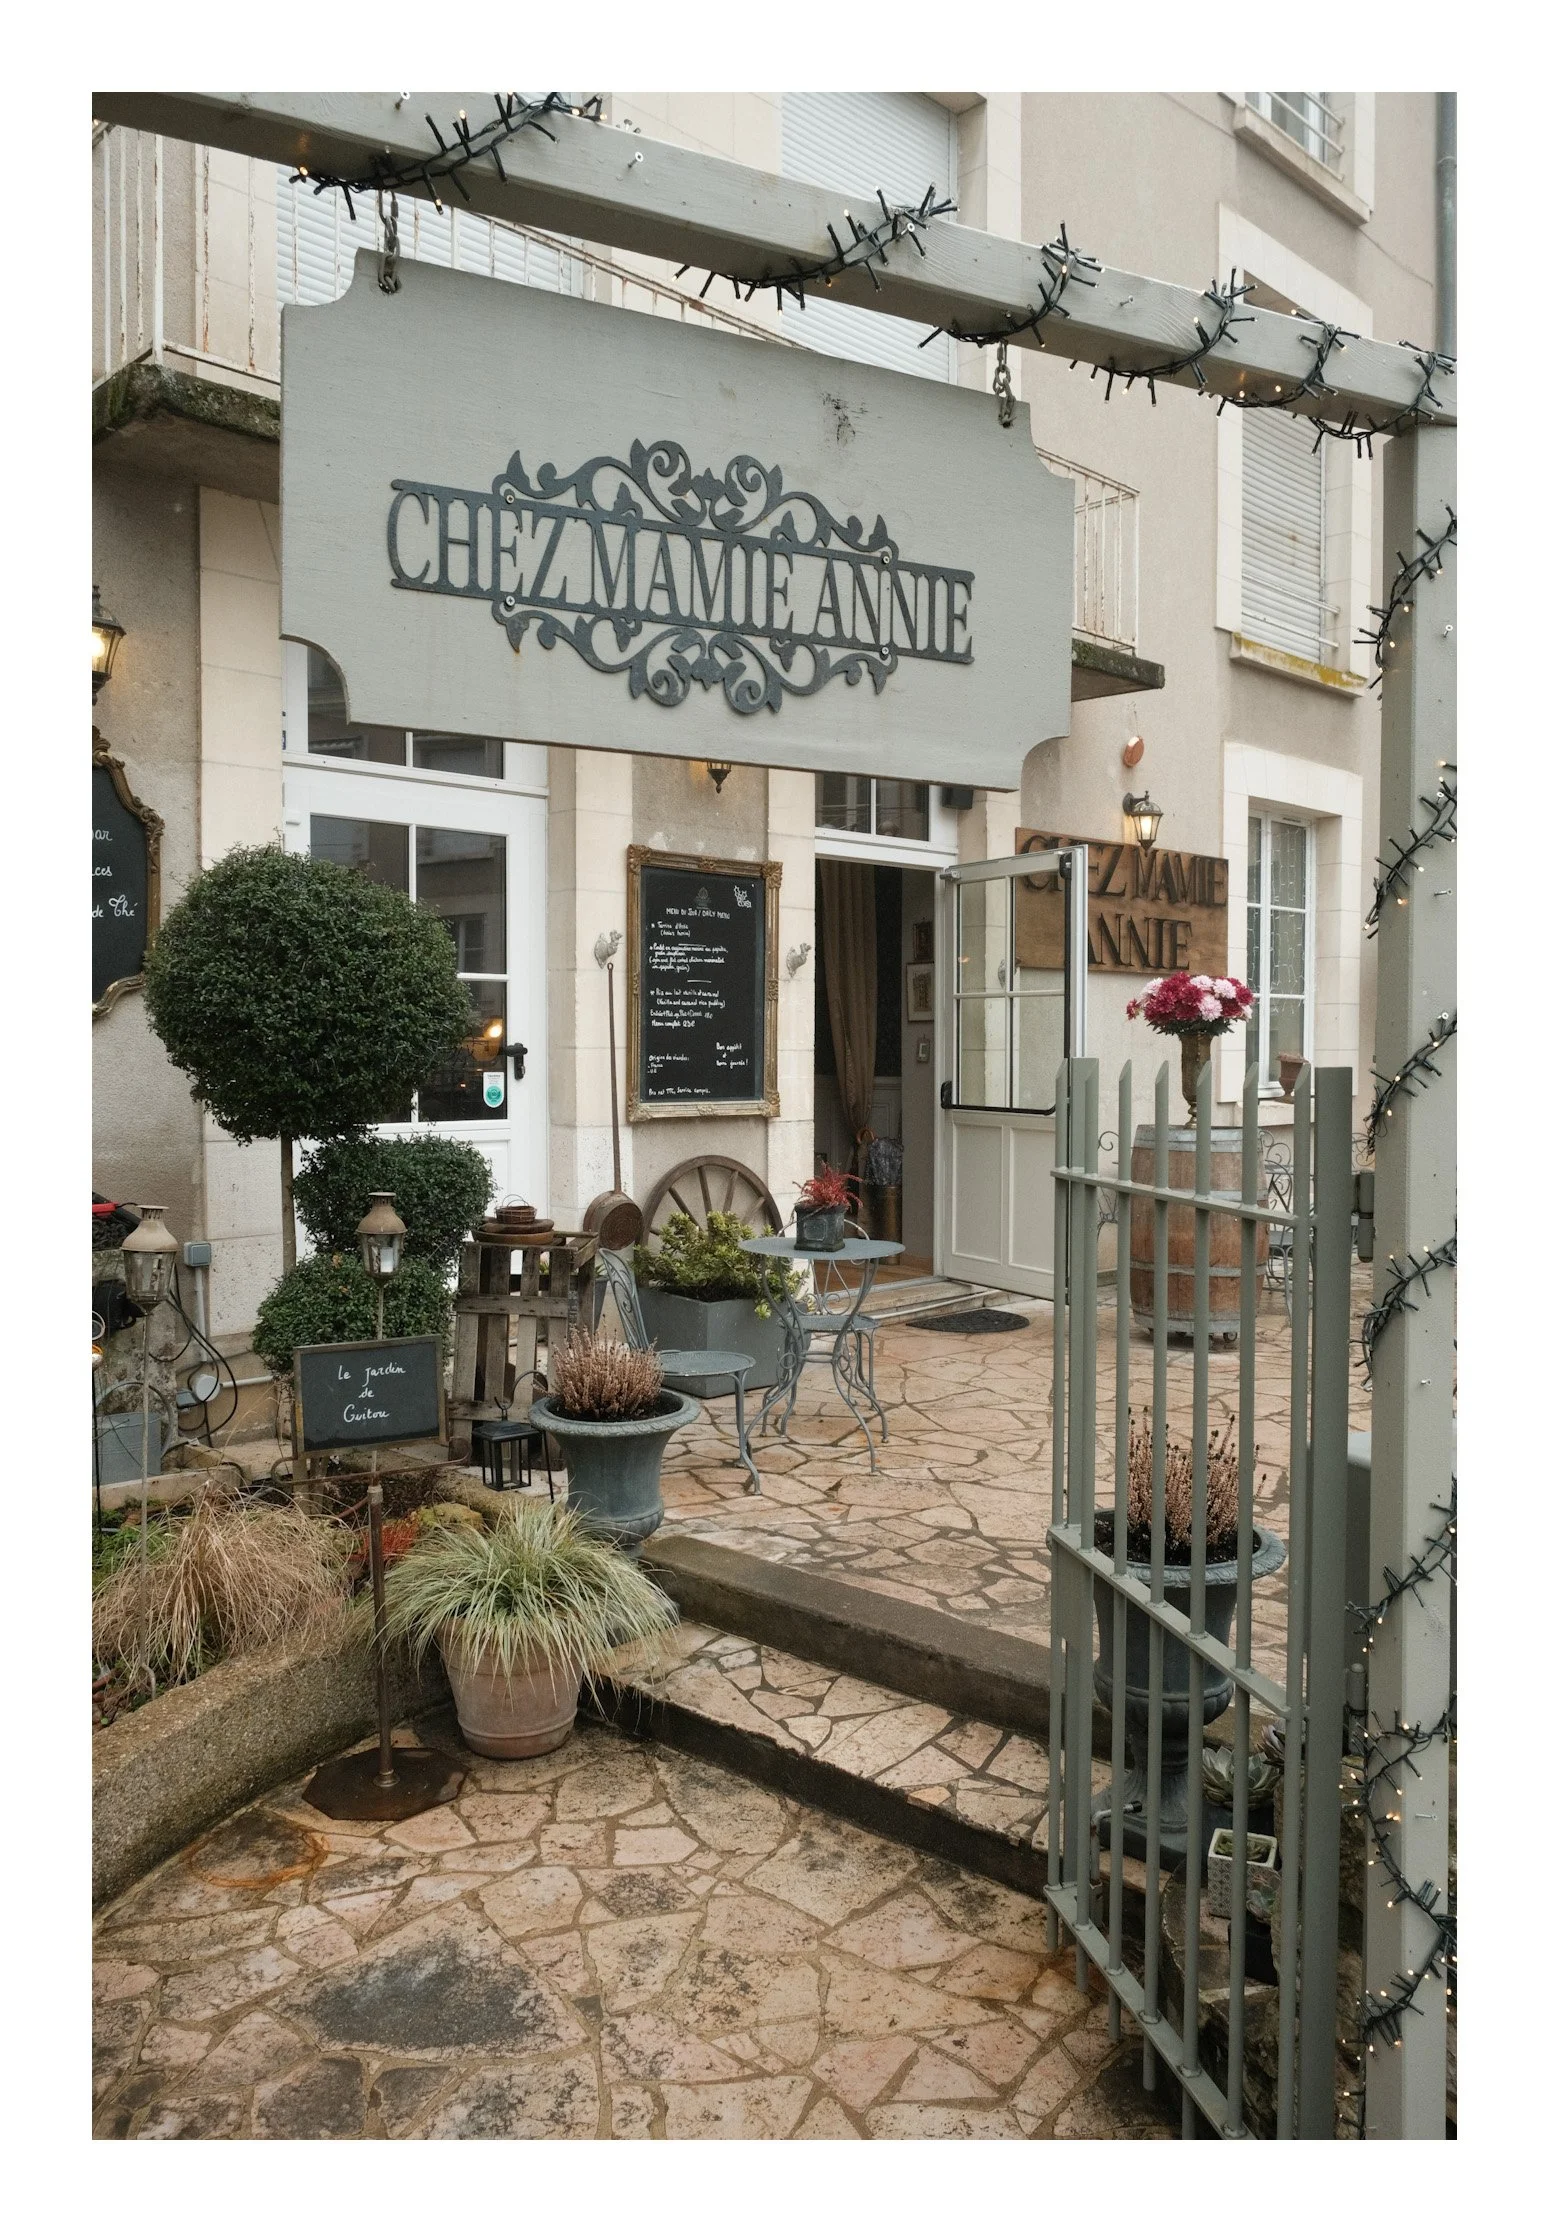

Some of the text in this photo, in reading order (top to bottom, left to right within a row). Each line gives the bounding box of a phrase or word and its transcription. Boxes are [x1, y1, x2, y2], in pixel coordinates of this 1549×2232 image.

[387, 482, 974, 663] CHEZ MAMIE ANNIE
[92, 829, 113, 841] ar
[1131, 847, 1229, 907] MAMIE
[108, 894, 138, 917] Thé
[716, 1042, 725, 1051] Bon
[337, 1365, 352, 1381] Le
[358, 1387, 375, 1399] de
[343, 1403, 391, 1423] Guitou
